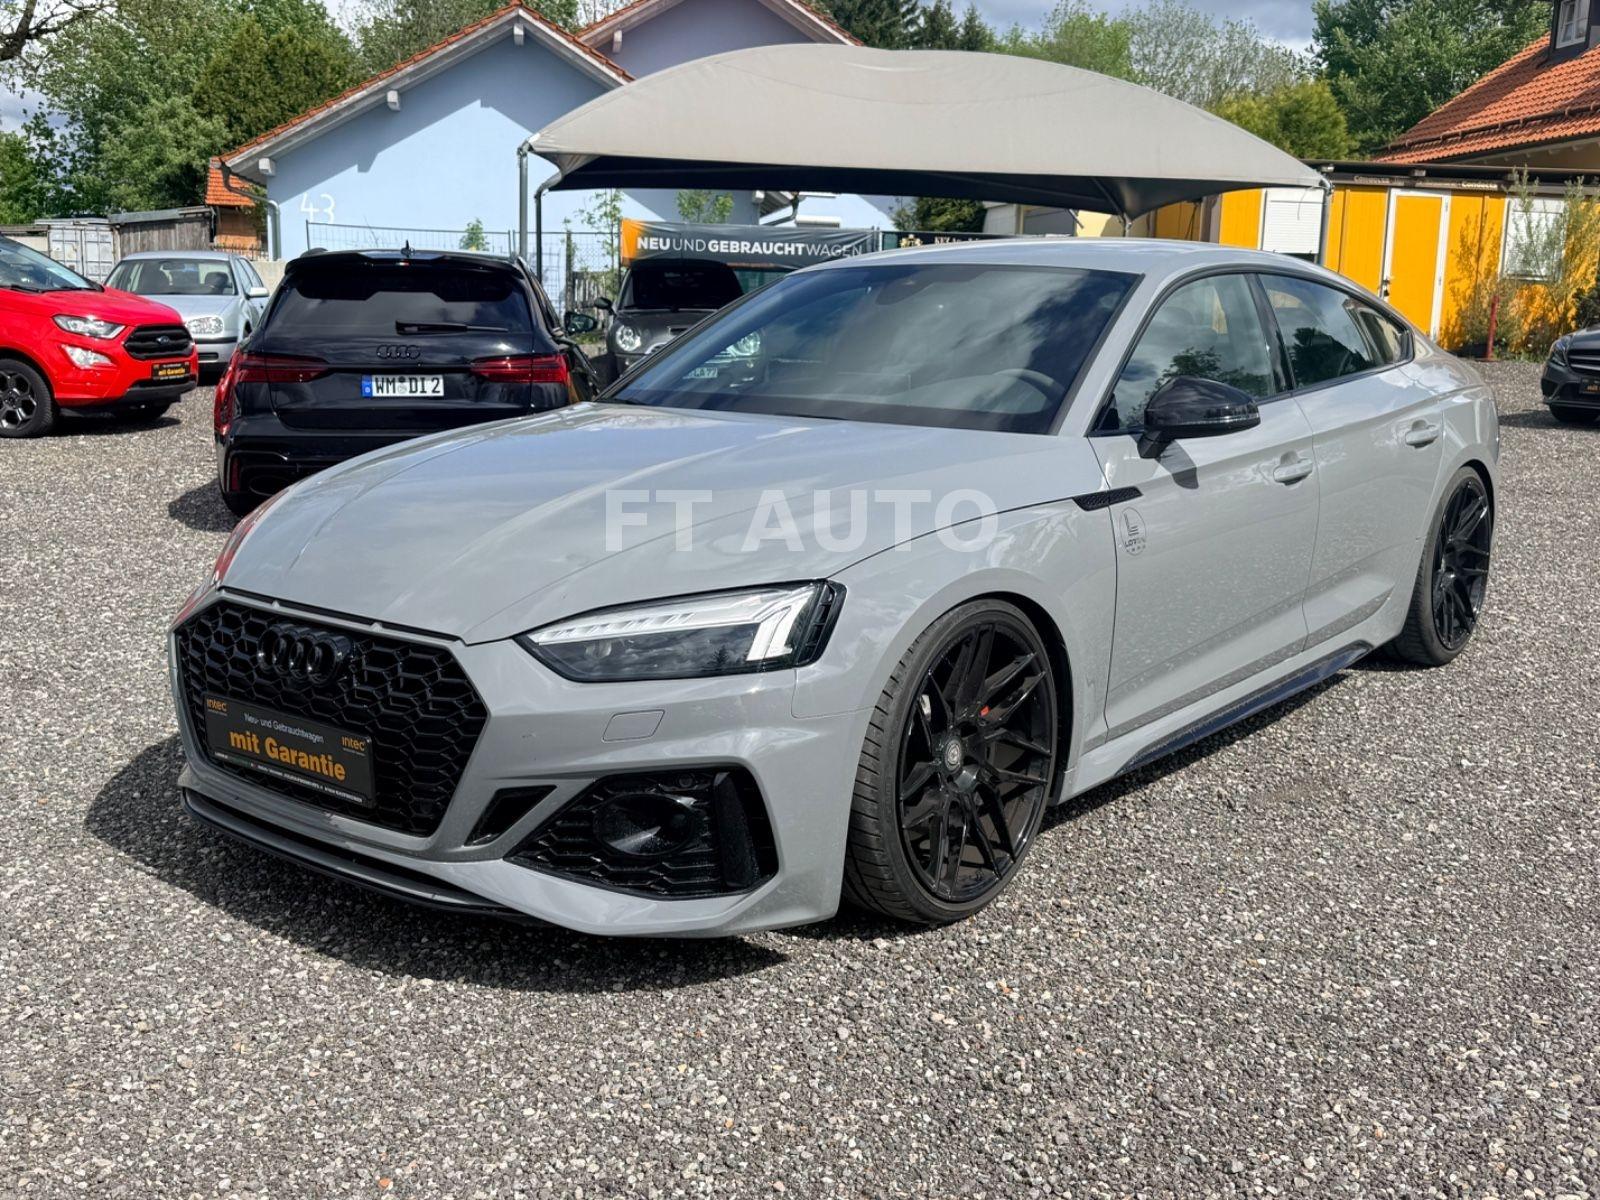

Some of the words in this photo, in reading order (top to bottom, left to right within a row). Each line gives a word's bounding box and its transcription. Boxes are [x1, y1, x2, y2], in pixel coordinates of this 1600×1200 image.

[300, 192, 335, 225] 43
[637, 237, 670, 250] NEU
[672, 239, 706, 252] UND
[374, 377, 396, 394] WM
[432, 377, 441, 394] 2
[261, 719, 273, 728] und
[229, 730, 260, 754] mit
[265, 736, 346, 781] Garantie
